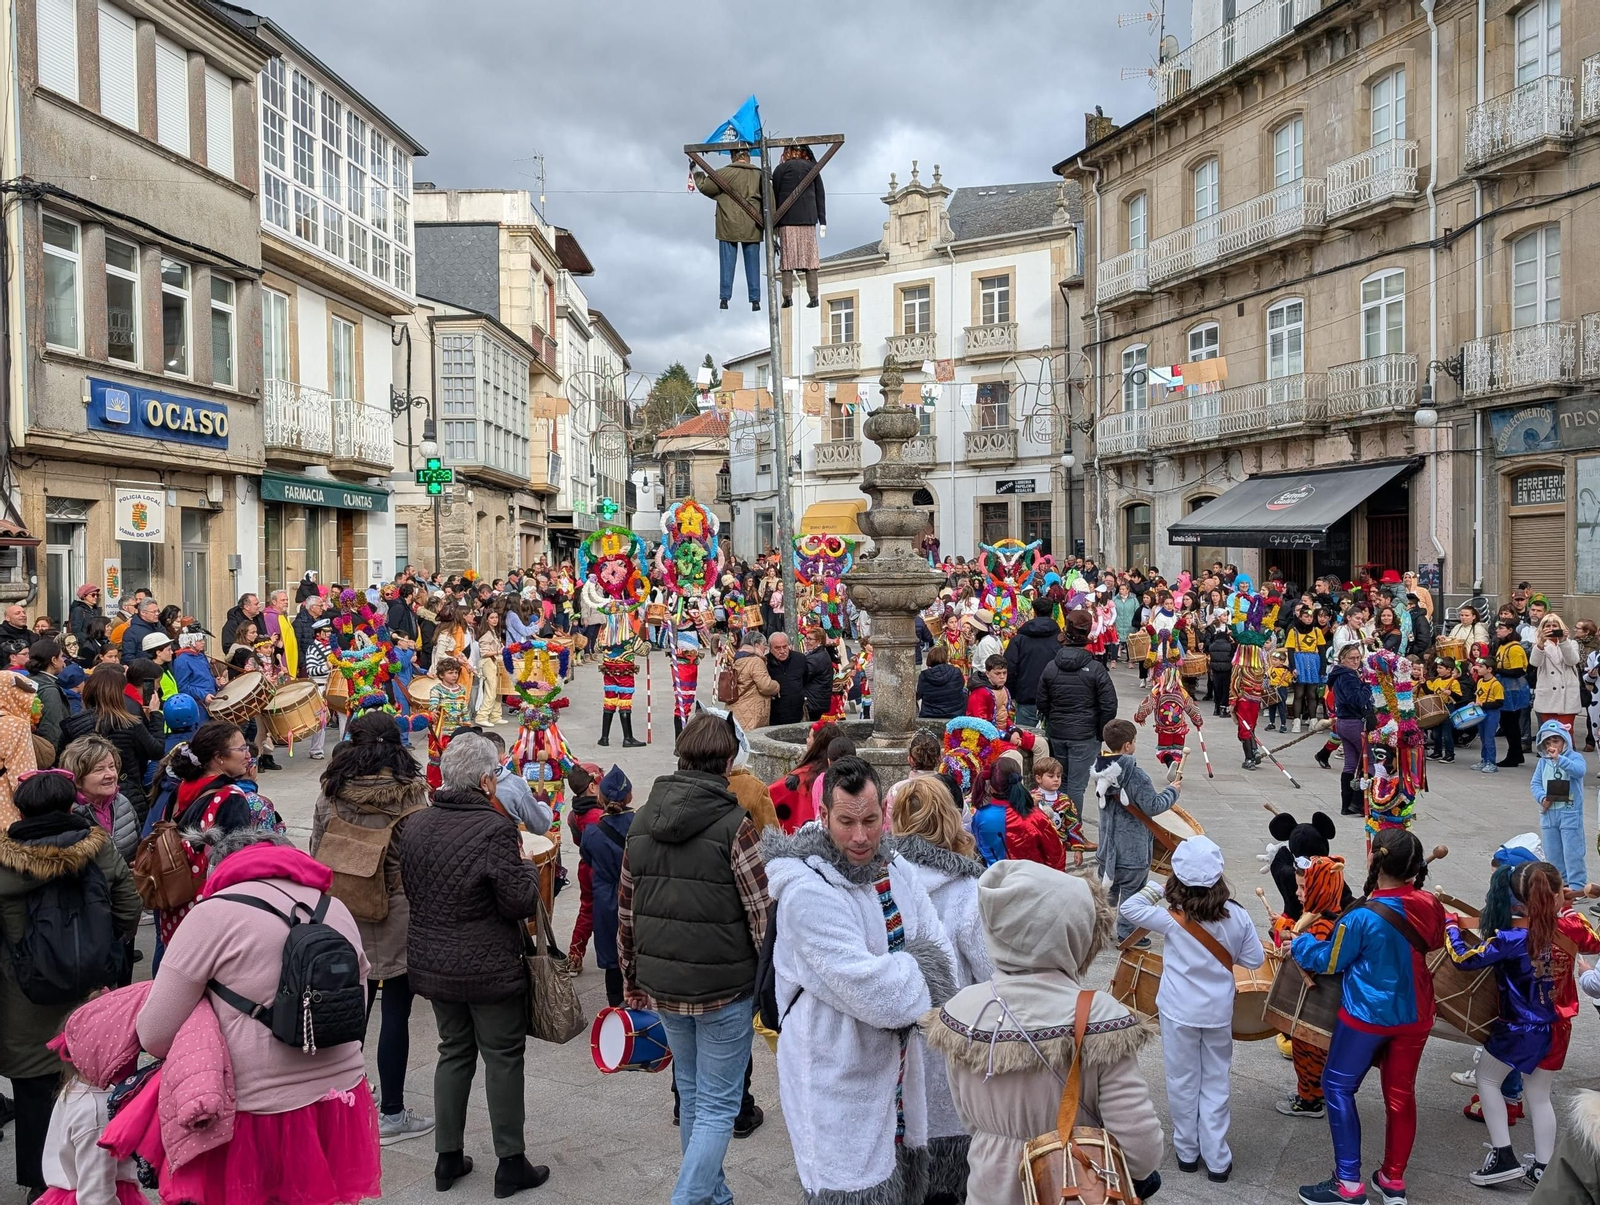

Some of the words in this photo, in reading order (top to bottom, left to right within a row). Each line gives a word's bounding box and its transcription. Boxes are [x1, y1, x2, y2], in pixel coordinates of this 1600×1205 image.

[147, 400, 229, 437] OCASO
[1560, 409, 1600, 428] TEO
[1497, 407, 1552, 452] ESTABLECIMIENTOS
[1517, 475, 1566, 490] FERRETERIA
[118, 494, 142, 504] POLICIA
[142, 494, 161, 507] LOCAL
[284, 485, 325, 502] FARMACIA
[343, 493, 373, 508] QUINTAS
[1517, 490, 1528, 503] EN
[1530, 488, 1566, 502] GENERAL
[119, 526, 135, 537] VIANA
[145, 528, 160, 537] BOLO
